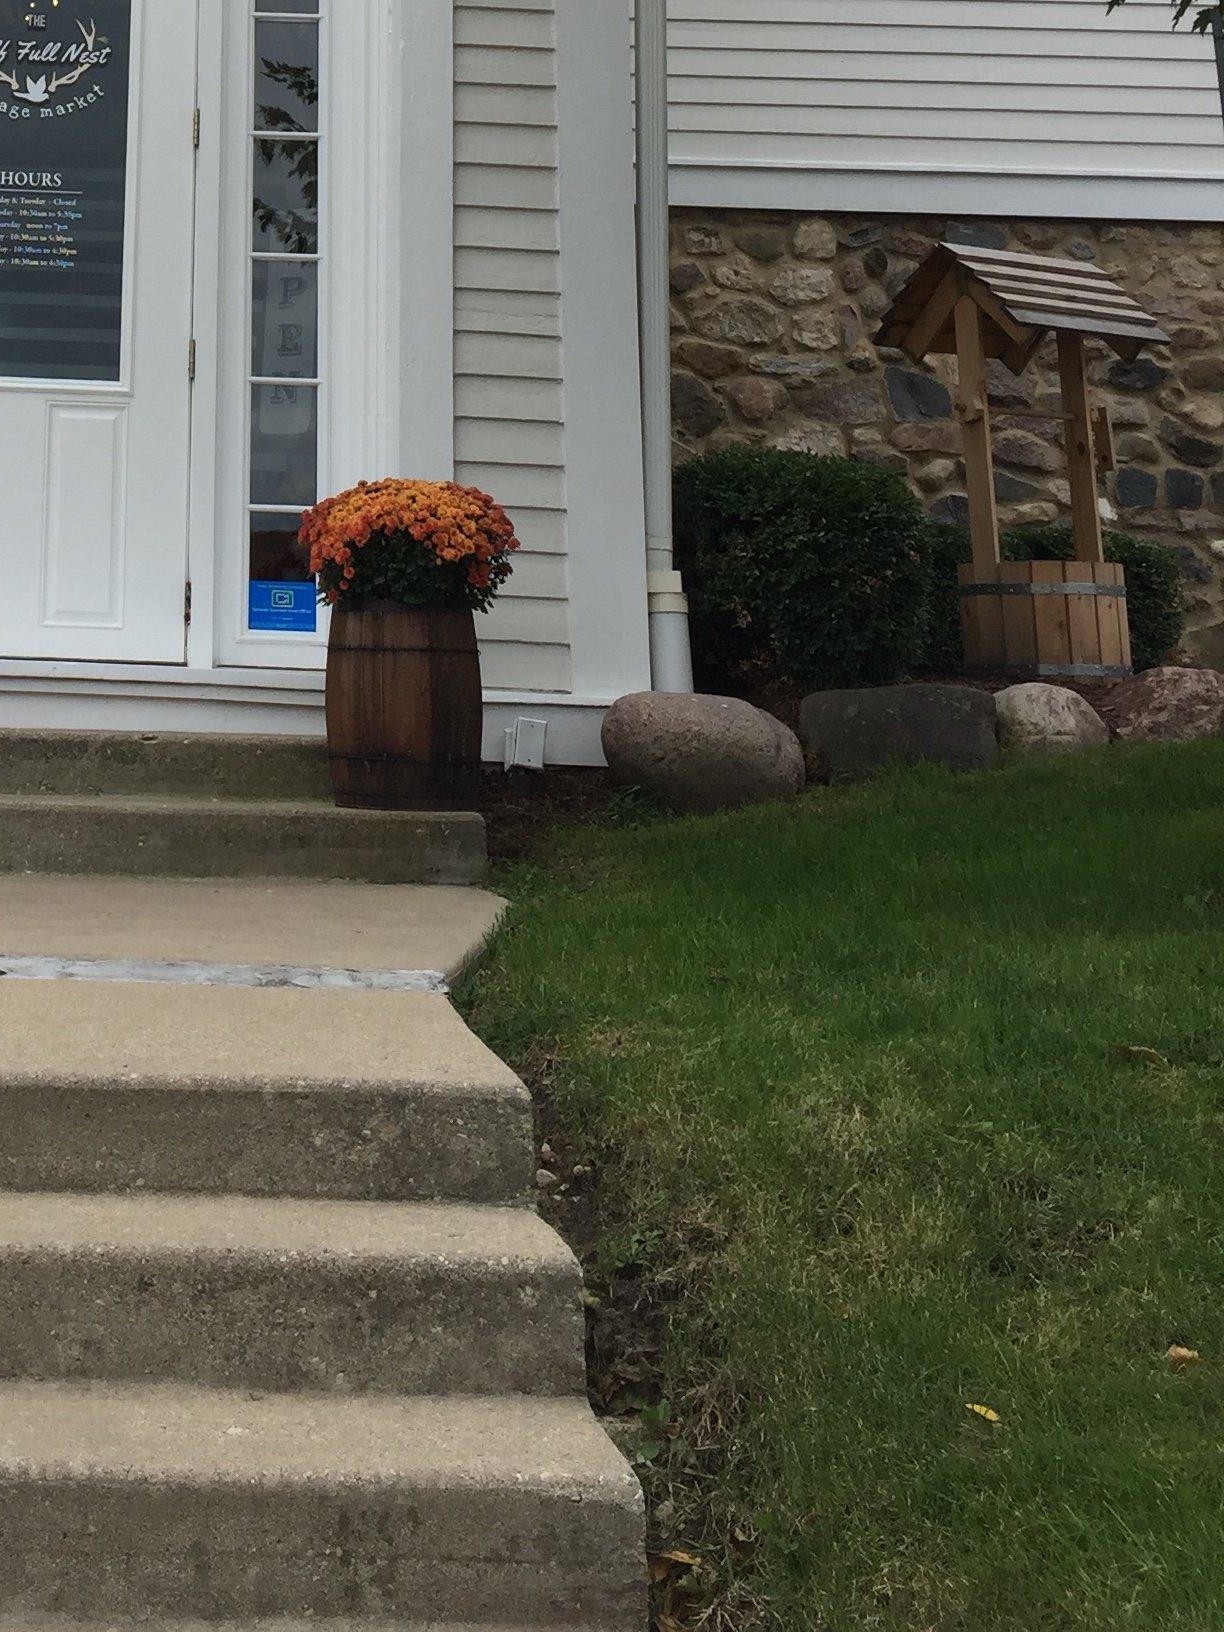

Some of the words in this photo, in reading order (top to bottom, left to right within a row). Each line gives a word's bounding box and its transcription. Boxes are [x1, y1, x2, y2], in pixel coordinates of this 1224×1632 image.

[27, 14, 46, 28] THE
[17, 41, 60, 63] Full
[61, 43, 111, 64] Nest
[40, 84, 105, 118] market
[0, 171, 63, 187] HOURS
[11, 196, 18, 205] &
[20, 196, 47, 207] Tuesday
[53, 198, 77, 206] Closed
[19, 209, 48, 218] 10:30am
[56, 210, 83, 220] 5:30pm
[10, 233, 39, 242] 10:30am
[39, 234, 47, 242] to
[13, 246, 42, 254] 10:30am
[11, 258, 40, 266] 10:30am
